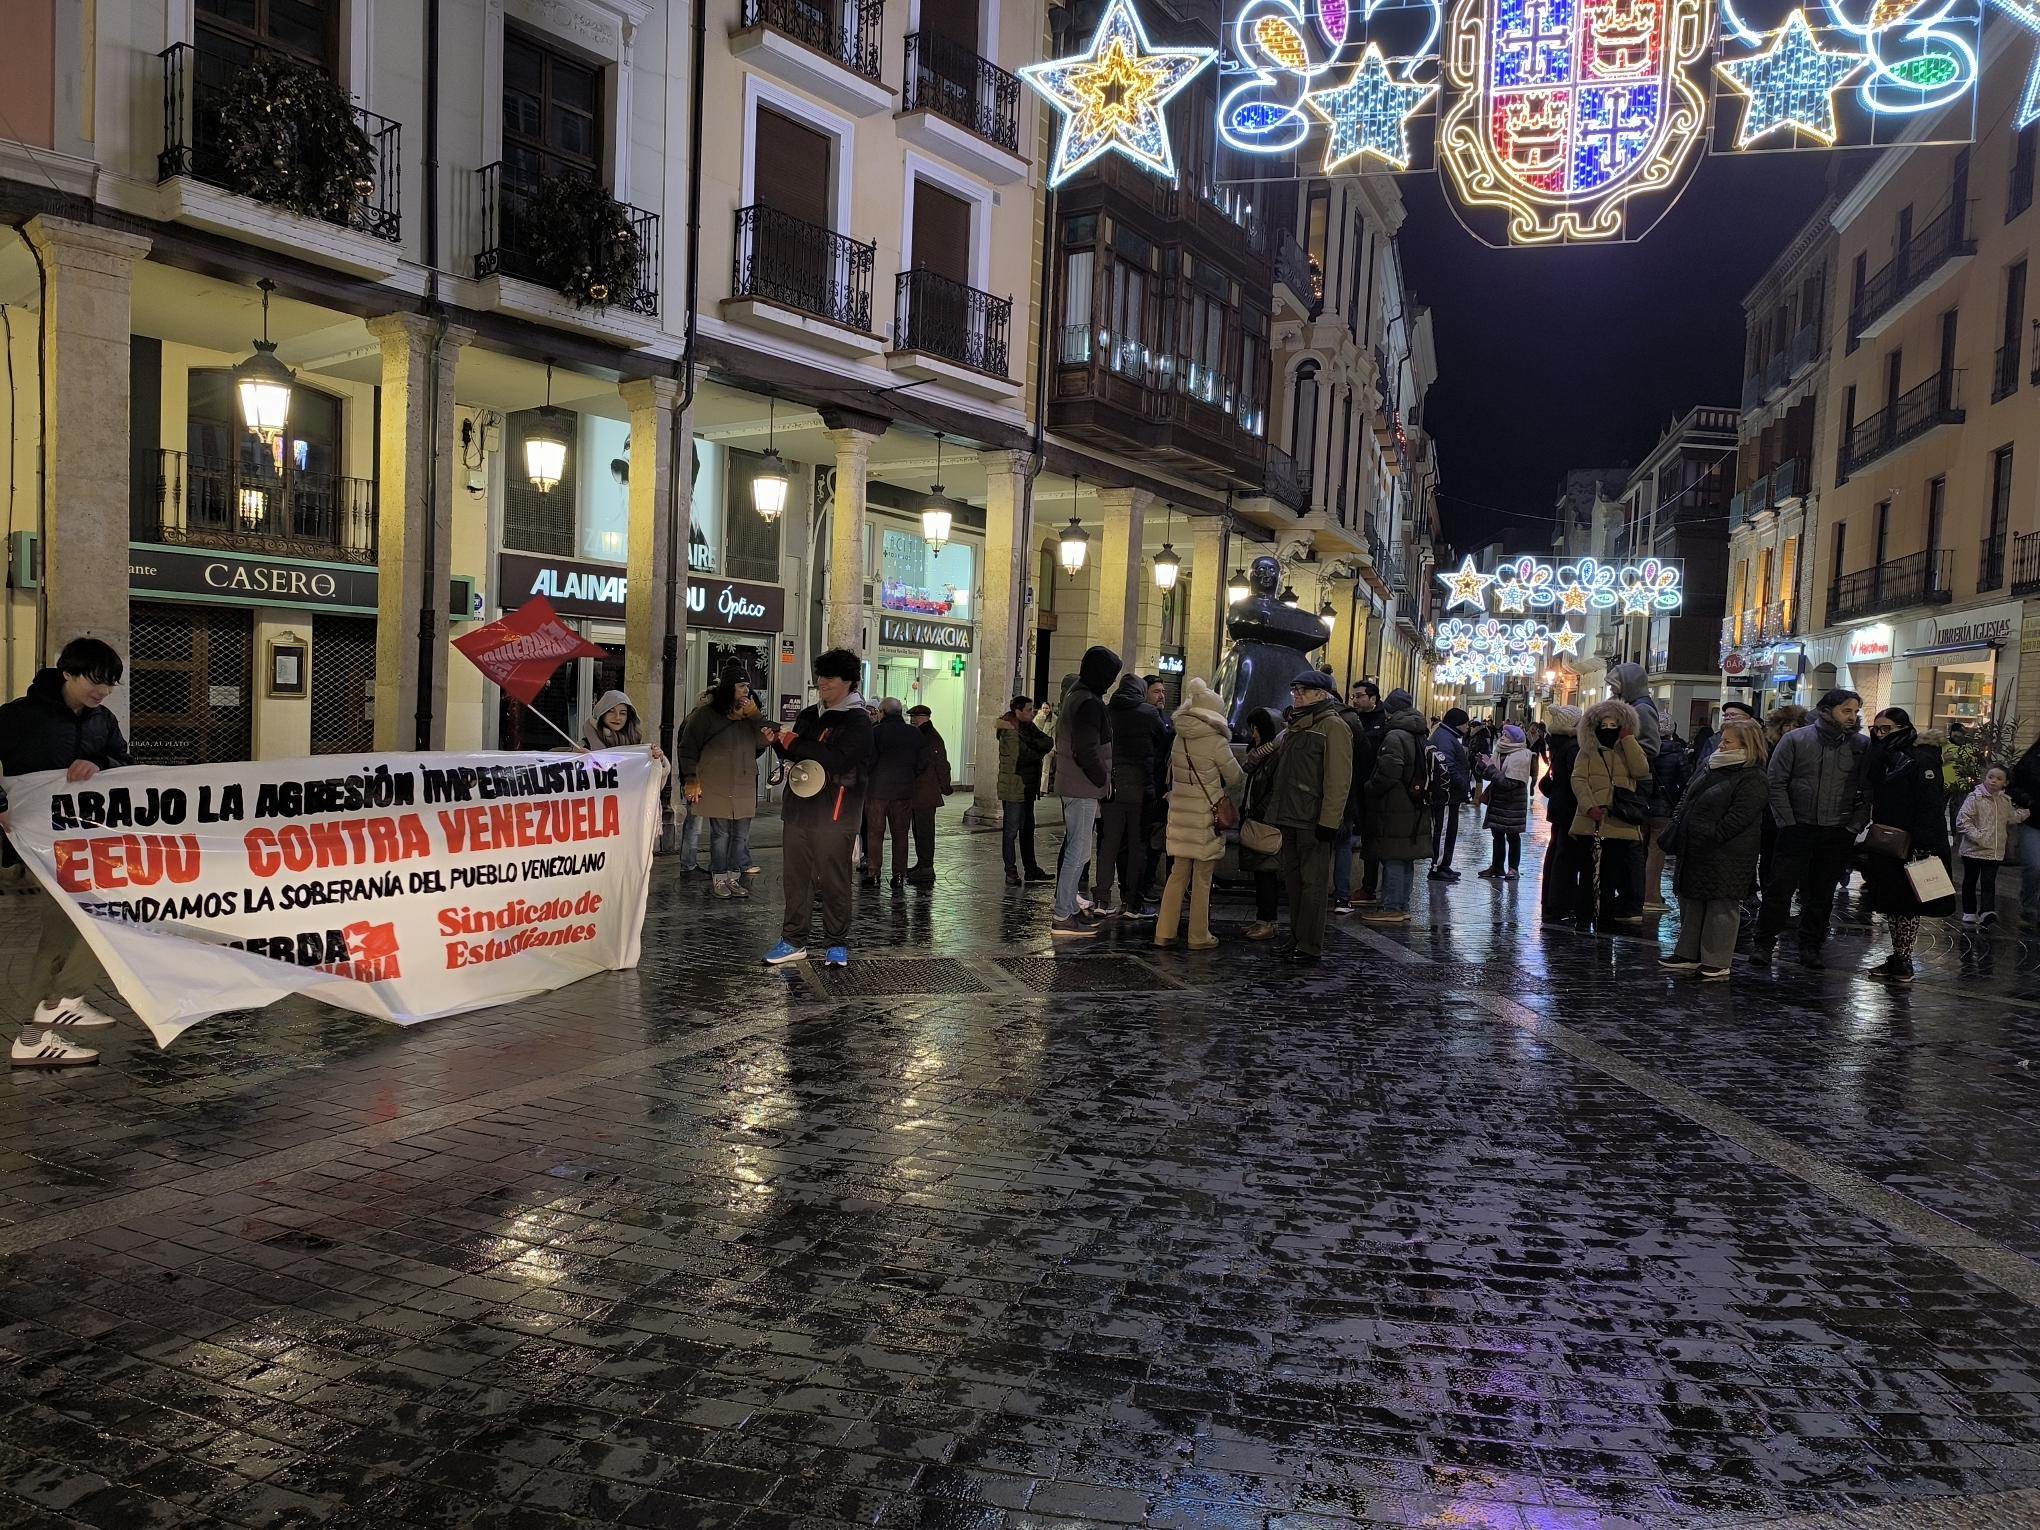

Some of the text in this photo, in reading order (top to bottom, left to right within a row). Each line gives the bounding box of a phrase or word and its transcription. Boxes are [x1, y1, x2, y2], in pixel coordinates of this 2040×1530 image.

[718, 585, 766, 623] Óptico
[885, 619, 970, 648] FARMACIA
[1937, 621, 1972, 645] LIBRERÍA
[1973, 618, 2011, 640] IGLESIAS
[51, 787, 187, 831] ABAJO
[197, 784, 244, 822] LA
[255, 764, 414, 818] AGRESIÓN
[54, 795, 620, 893] EEUU CONTRA VENEZUELA
[243, 886, 275, 914] LA
[279, 870, 404, 910] SOBERANÍA
[409, 870, 447, 894] DEL
[450, 862, 518, 890] PUEBLO
[521, 852, 606, 881] VENEZOLANO
[437, 890, 603, 937] Sindicato de
[446, 922, 597, 970] Estudiantes
